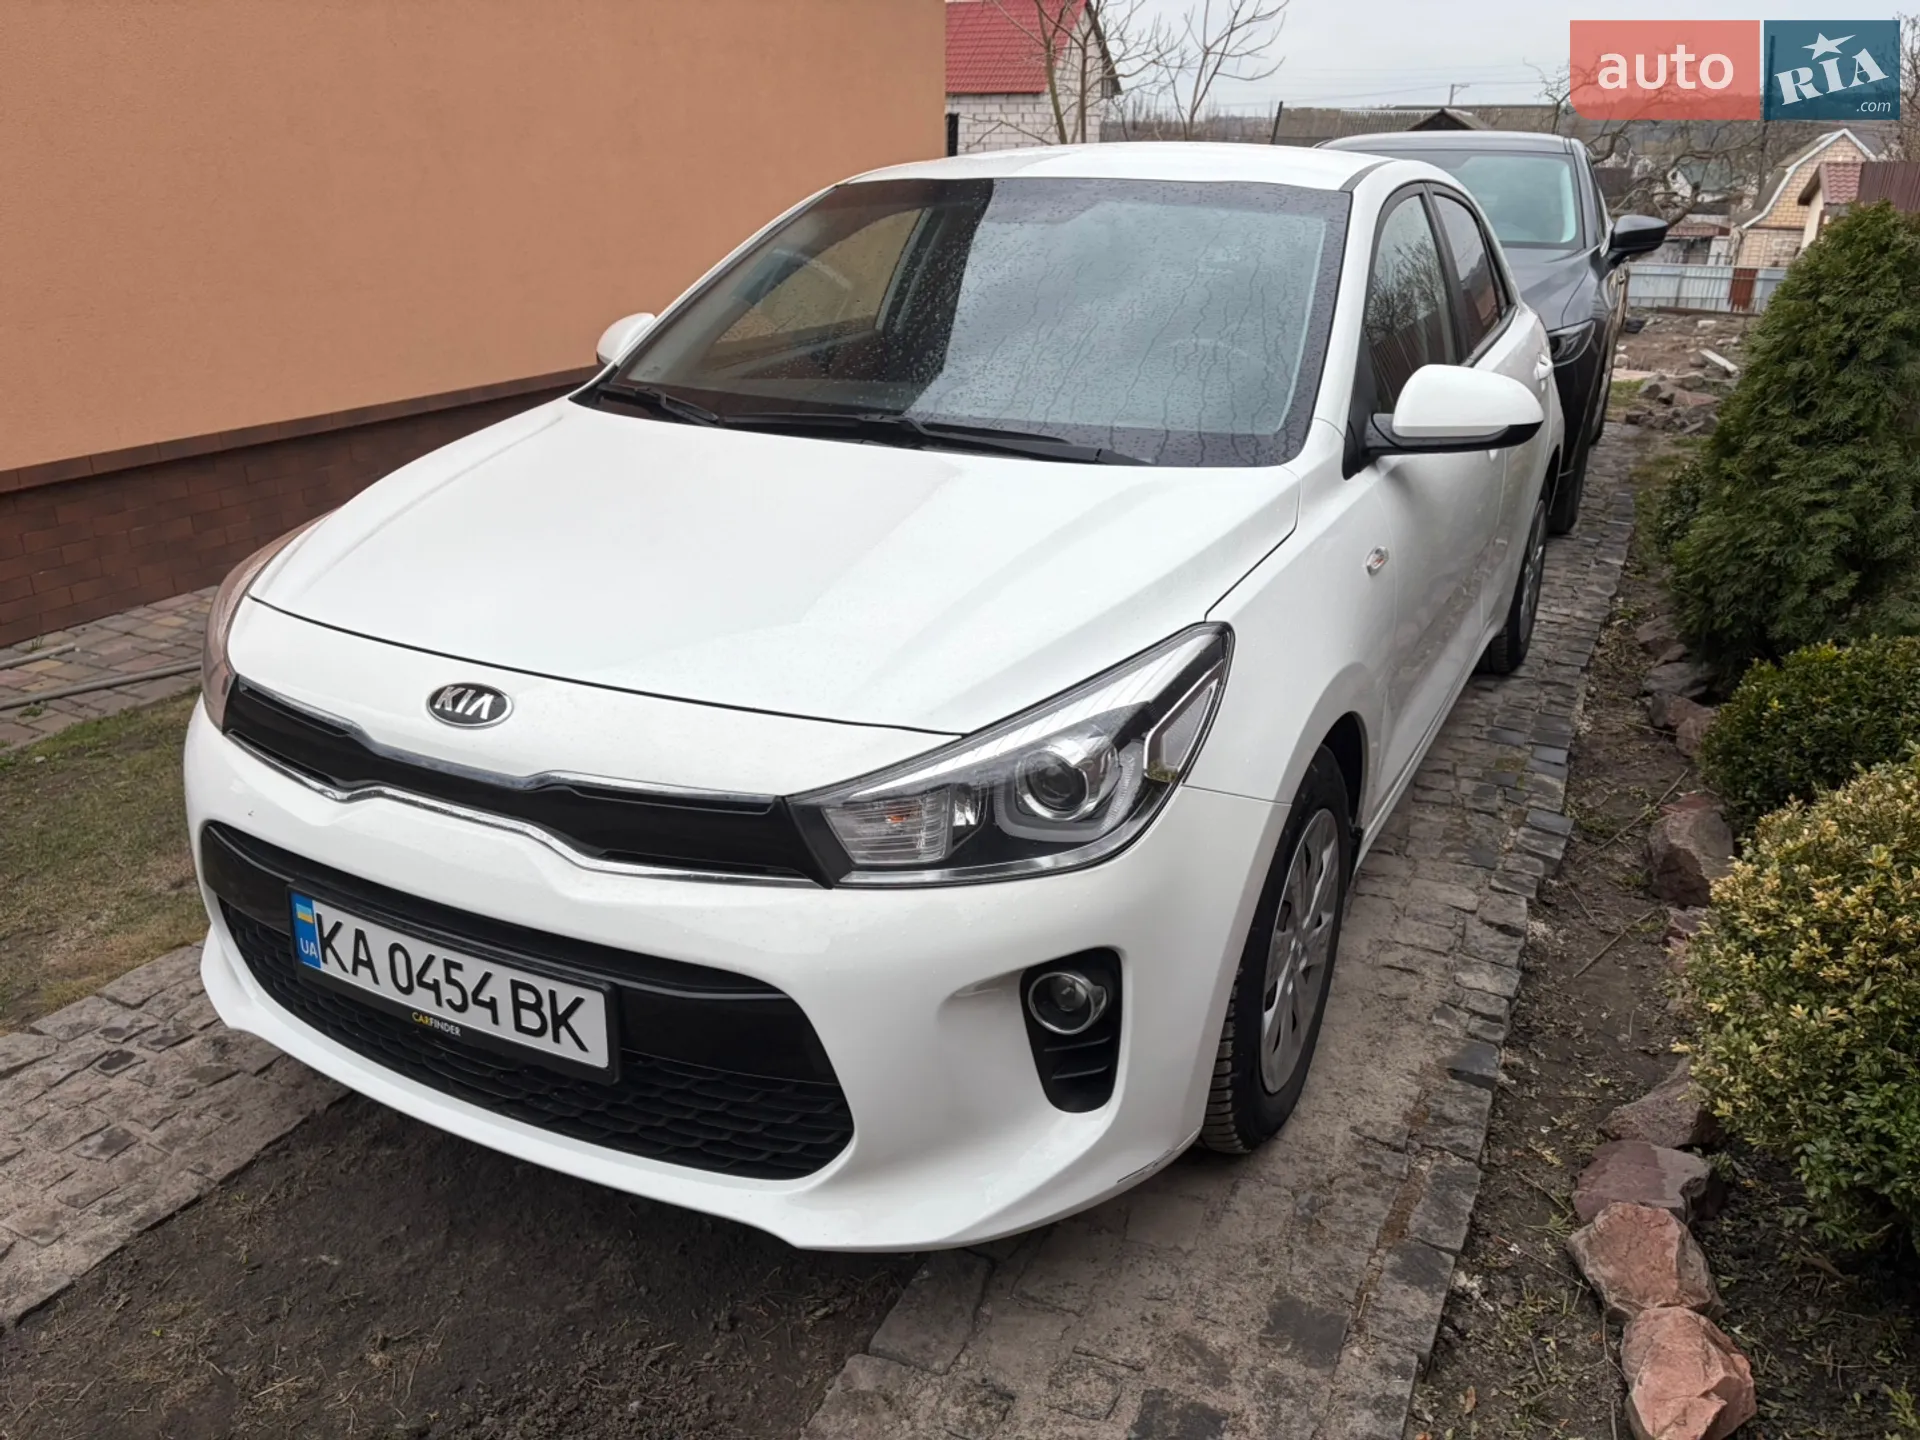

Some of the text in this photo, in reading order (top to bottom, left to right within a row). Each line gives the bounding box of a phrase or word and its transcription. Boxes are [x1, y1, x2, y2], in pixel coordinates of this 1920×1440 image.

[434, 686, 495, 720] KIA
[300, 937, 318, 959] UA
[316, 912, 589, 1053] KA 0454 BK
[411, 1011, 462, 1037] CARFINDER
